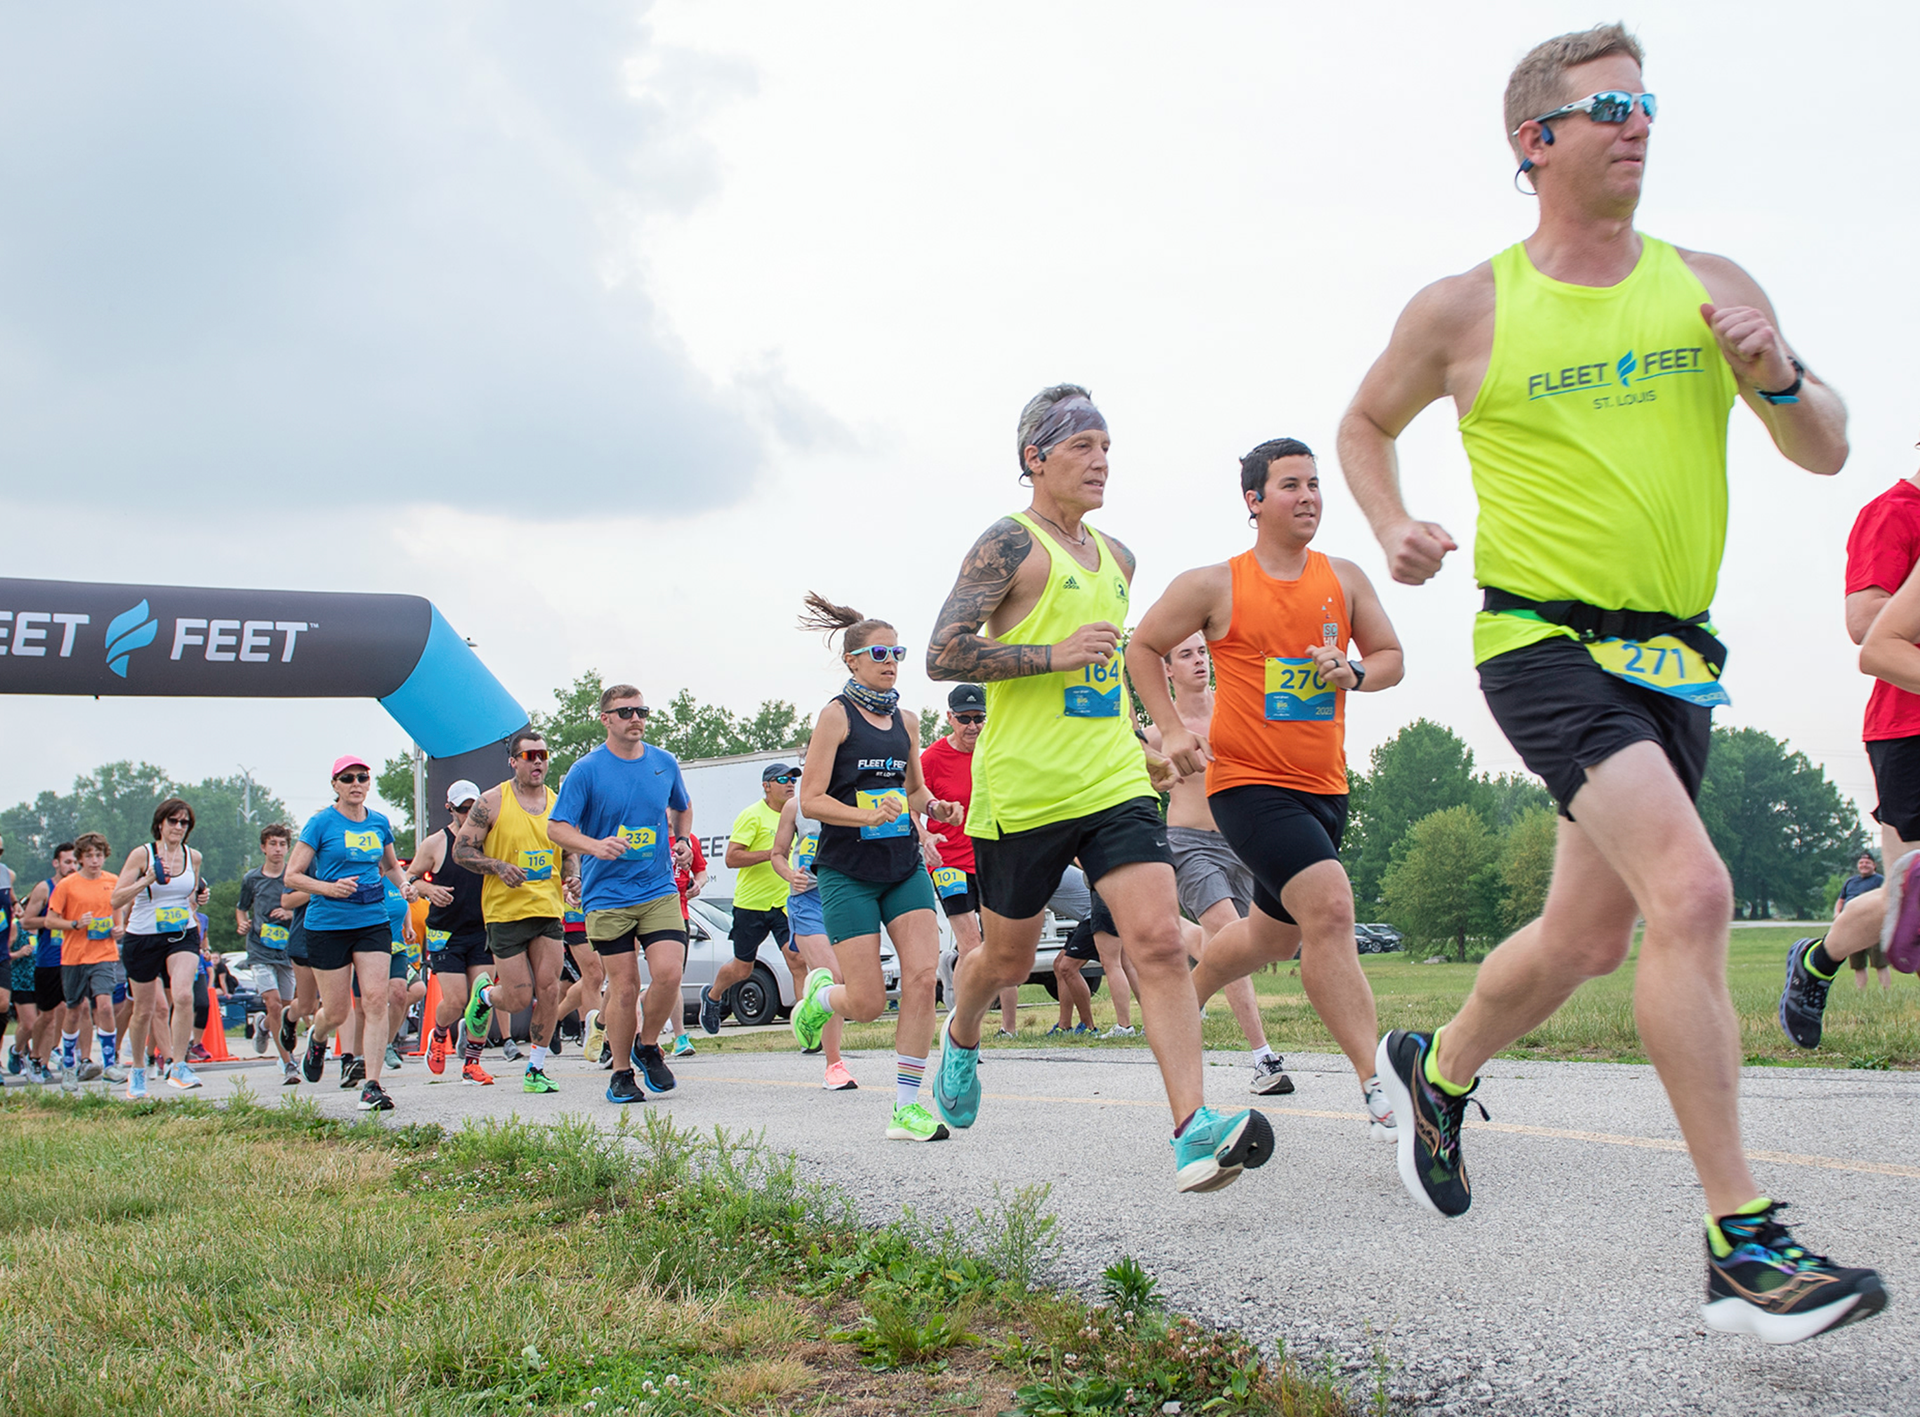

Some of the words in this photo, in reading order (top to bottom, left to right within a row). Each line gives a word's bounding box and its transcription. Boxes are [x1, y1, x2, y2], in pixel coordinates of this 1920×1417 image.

[1528, 362, 1609, 396] FLEET
[1643, 347, 1702, 374] FEET
[1593, 397, 1613, 410] ST.
[1617, 390, 1657, 407] LOUIS
[1324, 624, 1337, 635] SC
[170, 618, 308, 663] FEET
[1621, 643, 1685, 679] 271
[1085, 660, 1119, 683] 164
[858, 759, 885, 768] FLEET
[359, 836, 371, 846] 21
[626, 832, 649, 844] 232
[528, 856, 546, 867] 116
[938, 871, 957, 884] 101
[163, 911, 182, 920] 216
[266, 928, 286, 939] 249
